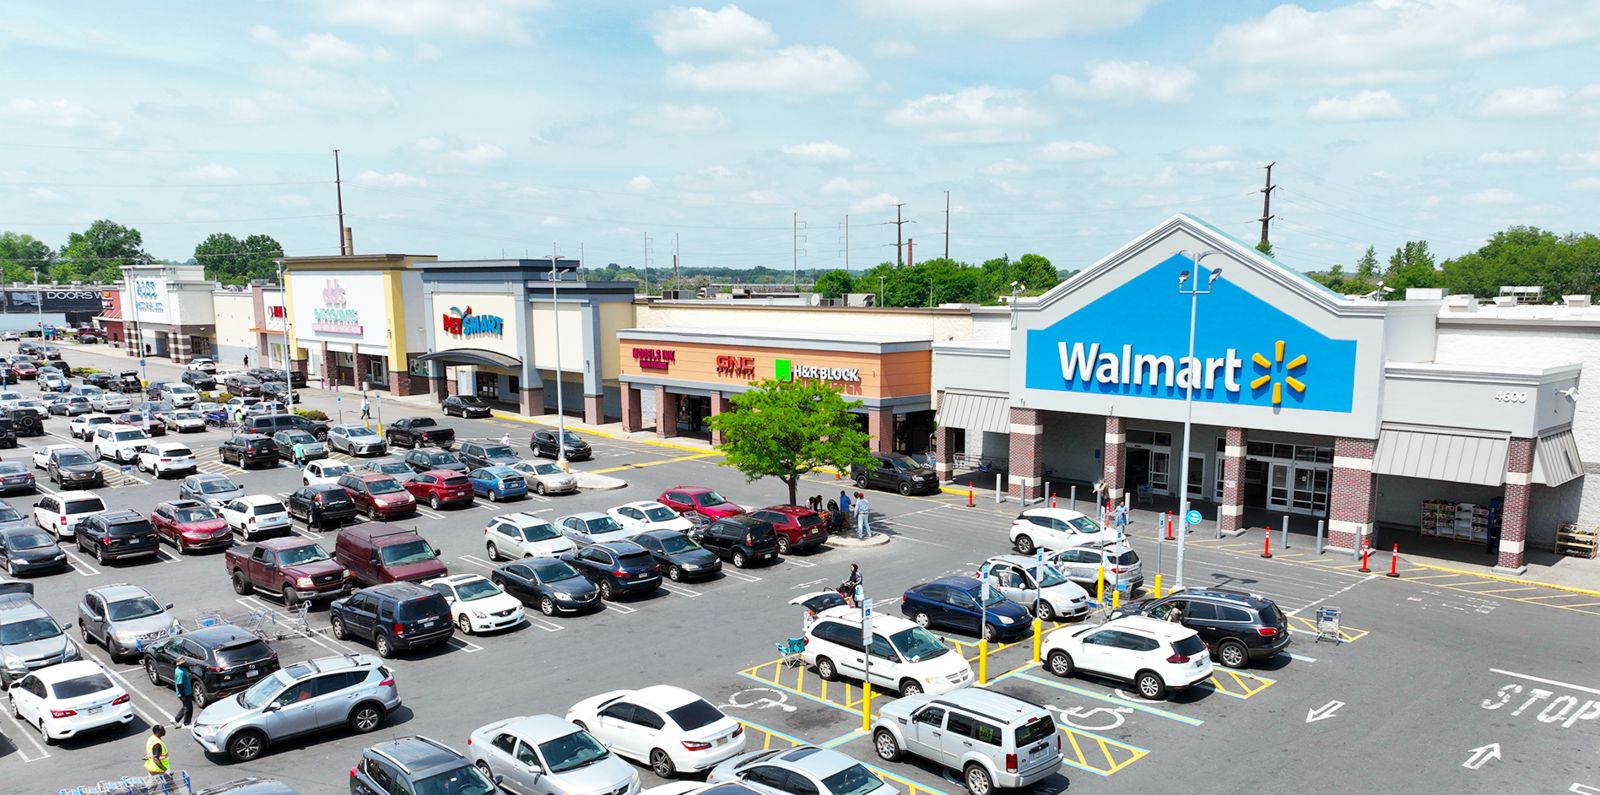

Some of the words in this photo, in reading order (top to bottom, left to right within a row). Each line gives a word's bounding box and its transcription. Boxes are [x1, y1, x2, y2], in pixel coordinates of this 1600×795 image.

[47, 291, 93, 300] DOORS
[716, 355, 755, 370] GNC
[1057, 340, 1243, 393] Walmart
[793, 364, 818, 378] H&R
[819, 367, 860, 382] BLOCK
[1494, 390, 1528, 404] 4600
[1480, 683, 1600, 729] STOP
